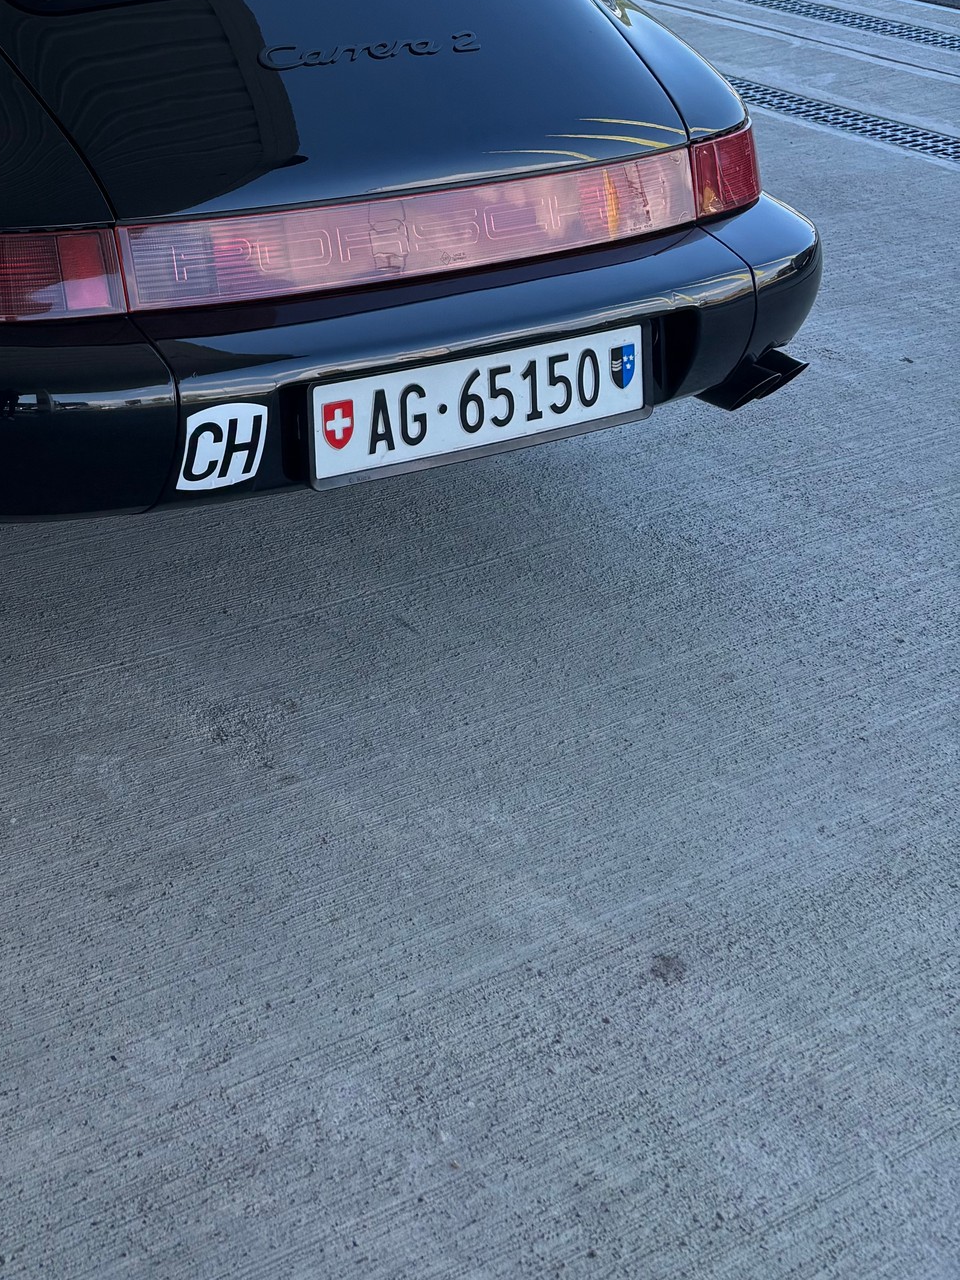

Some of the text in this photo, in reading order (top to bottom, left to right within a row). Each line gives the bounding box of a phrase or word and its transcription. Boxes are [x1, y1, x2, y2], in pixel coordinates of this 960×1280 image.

[256, 30, 482, 71] Carrera 2
[182, 414, 263, 482] CH
